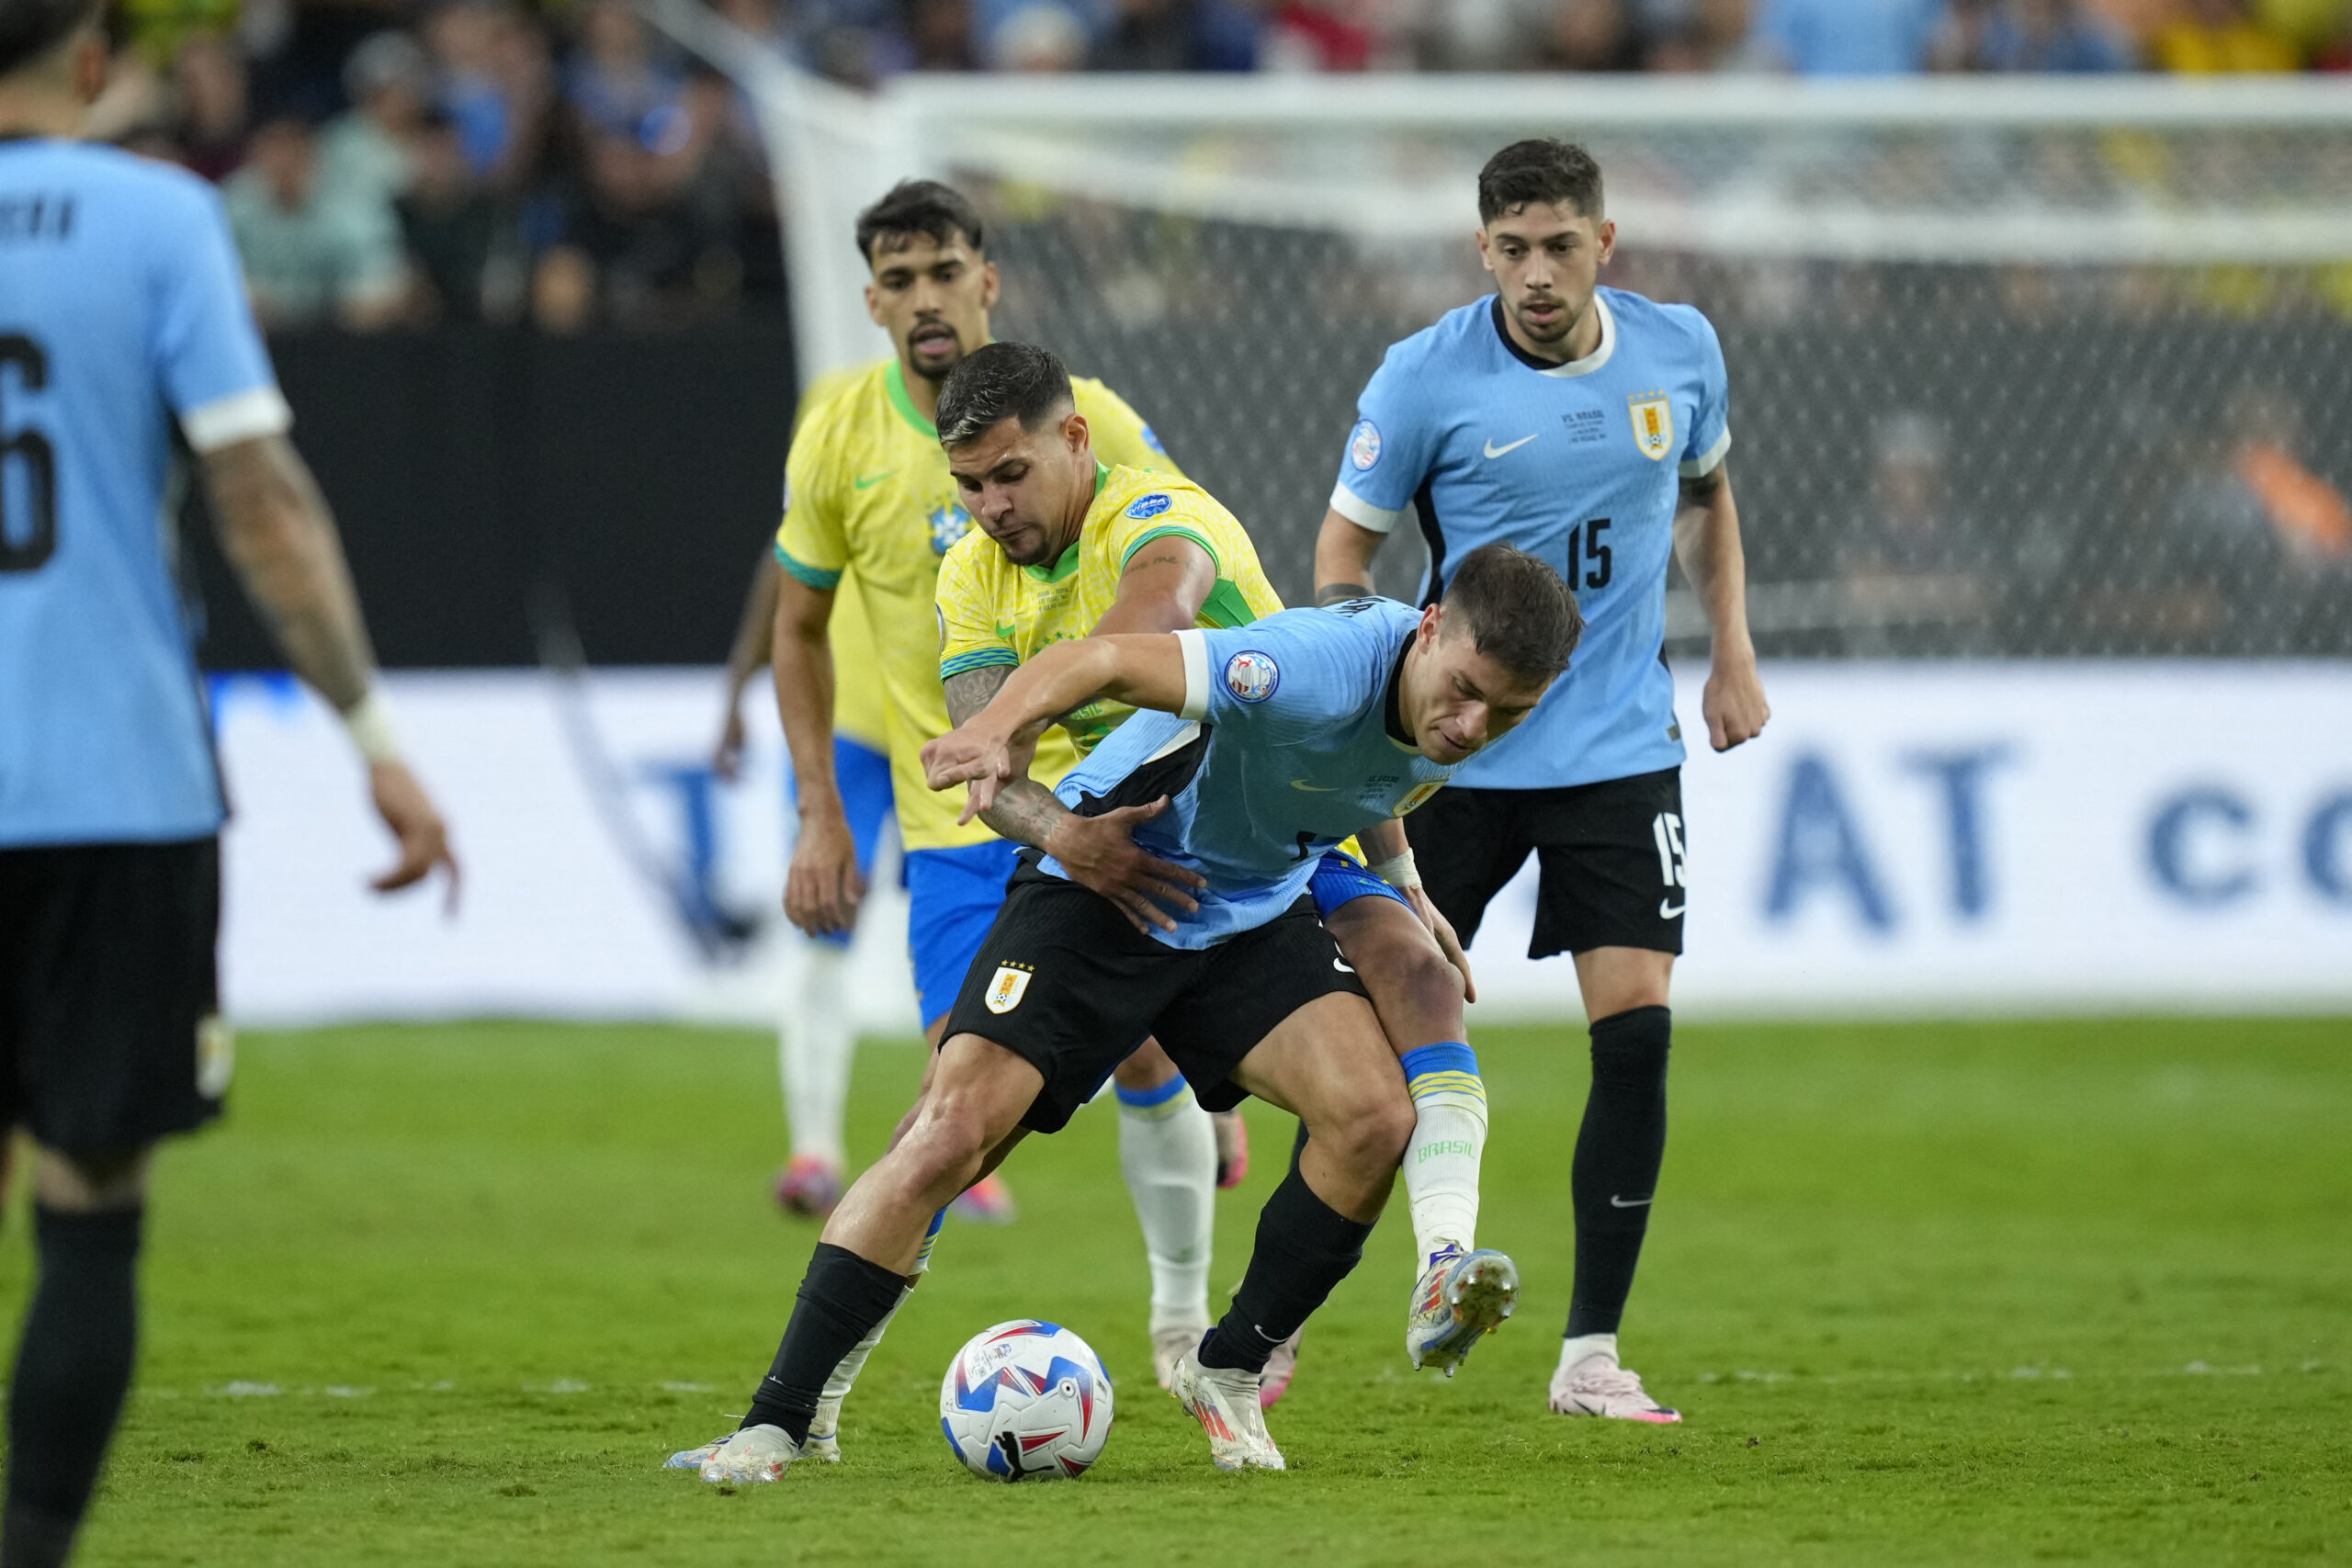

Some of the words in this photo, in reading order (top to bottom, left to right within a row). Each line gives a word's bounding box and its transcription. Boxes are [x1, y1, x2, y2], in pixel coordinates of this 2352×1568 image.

[1567, 518, 1611, 591] 15
[1653, 812, 1687, 887] 15
[1418, 1140, 1476, 1165] BRASIL
